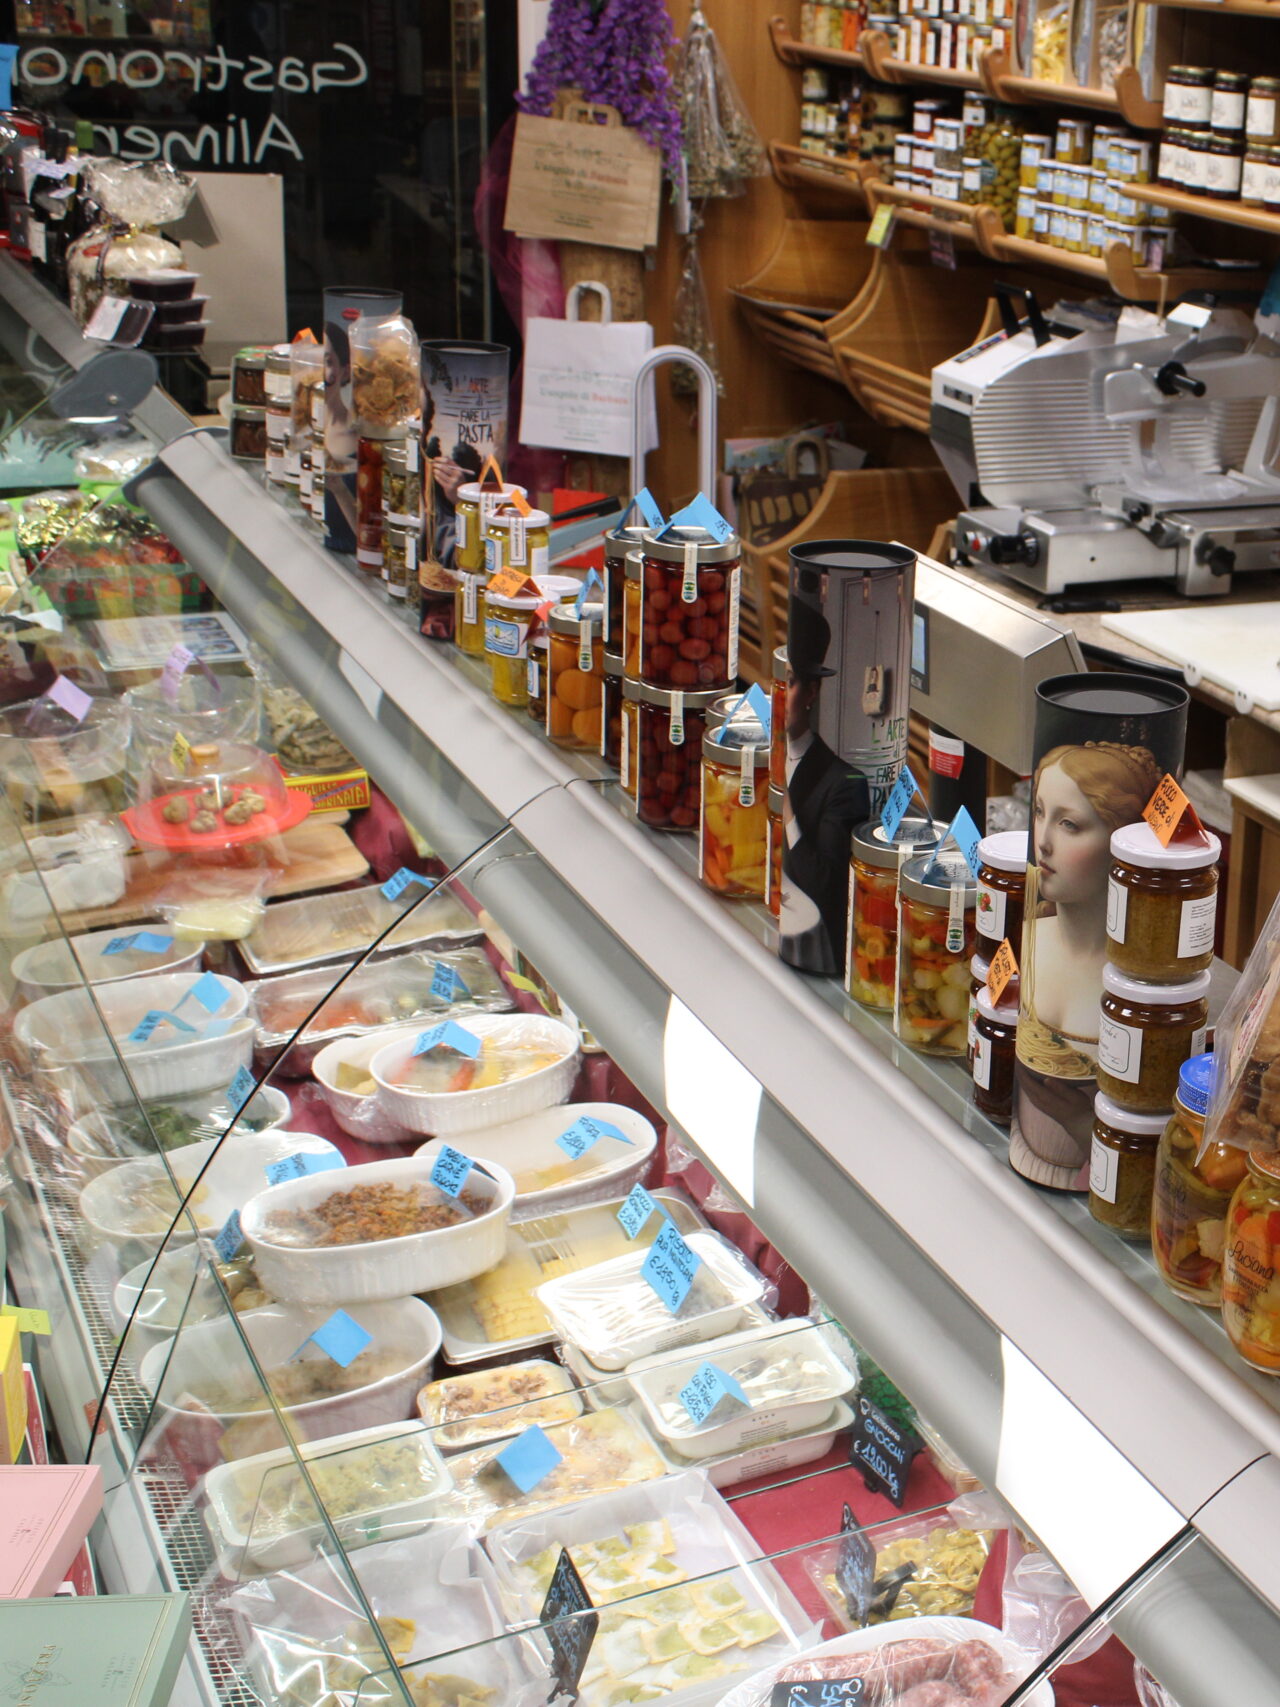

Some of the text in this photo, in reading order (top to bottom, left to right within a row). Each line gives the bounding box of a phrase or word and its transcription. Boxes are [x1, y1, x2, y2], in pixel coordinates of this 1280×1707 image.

[458, 423, 494, 443] PASTA
[876, 764, 896, 785] FARE
[864, 1418, 906, 1465] GNOCCHI
